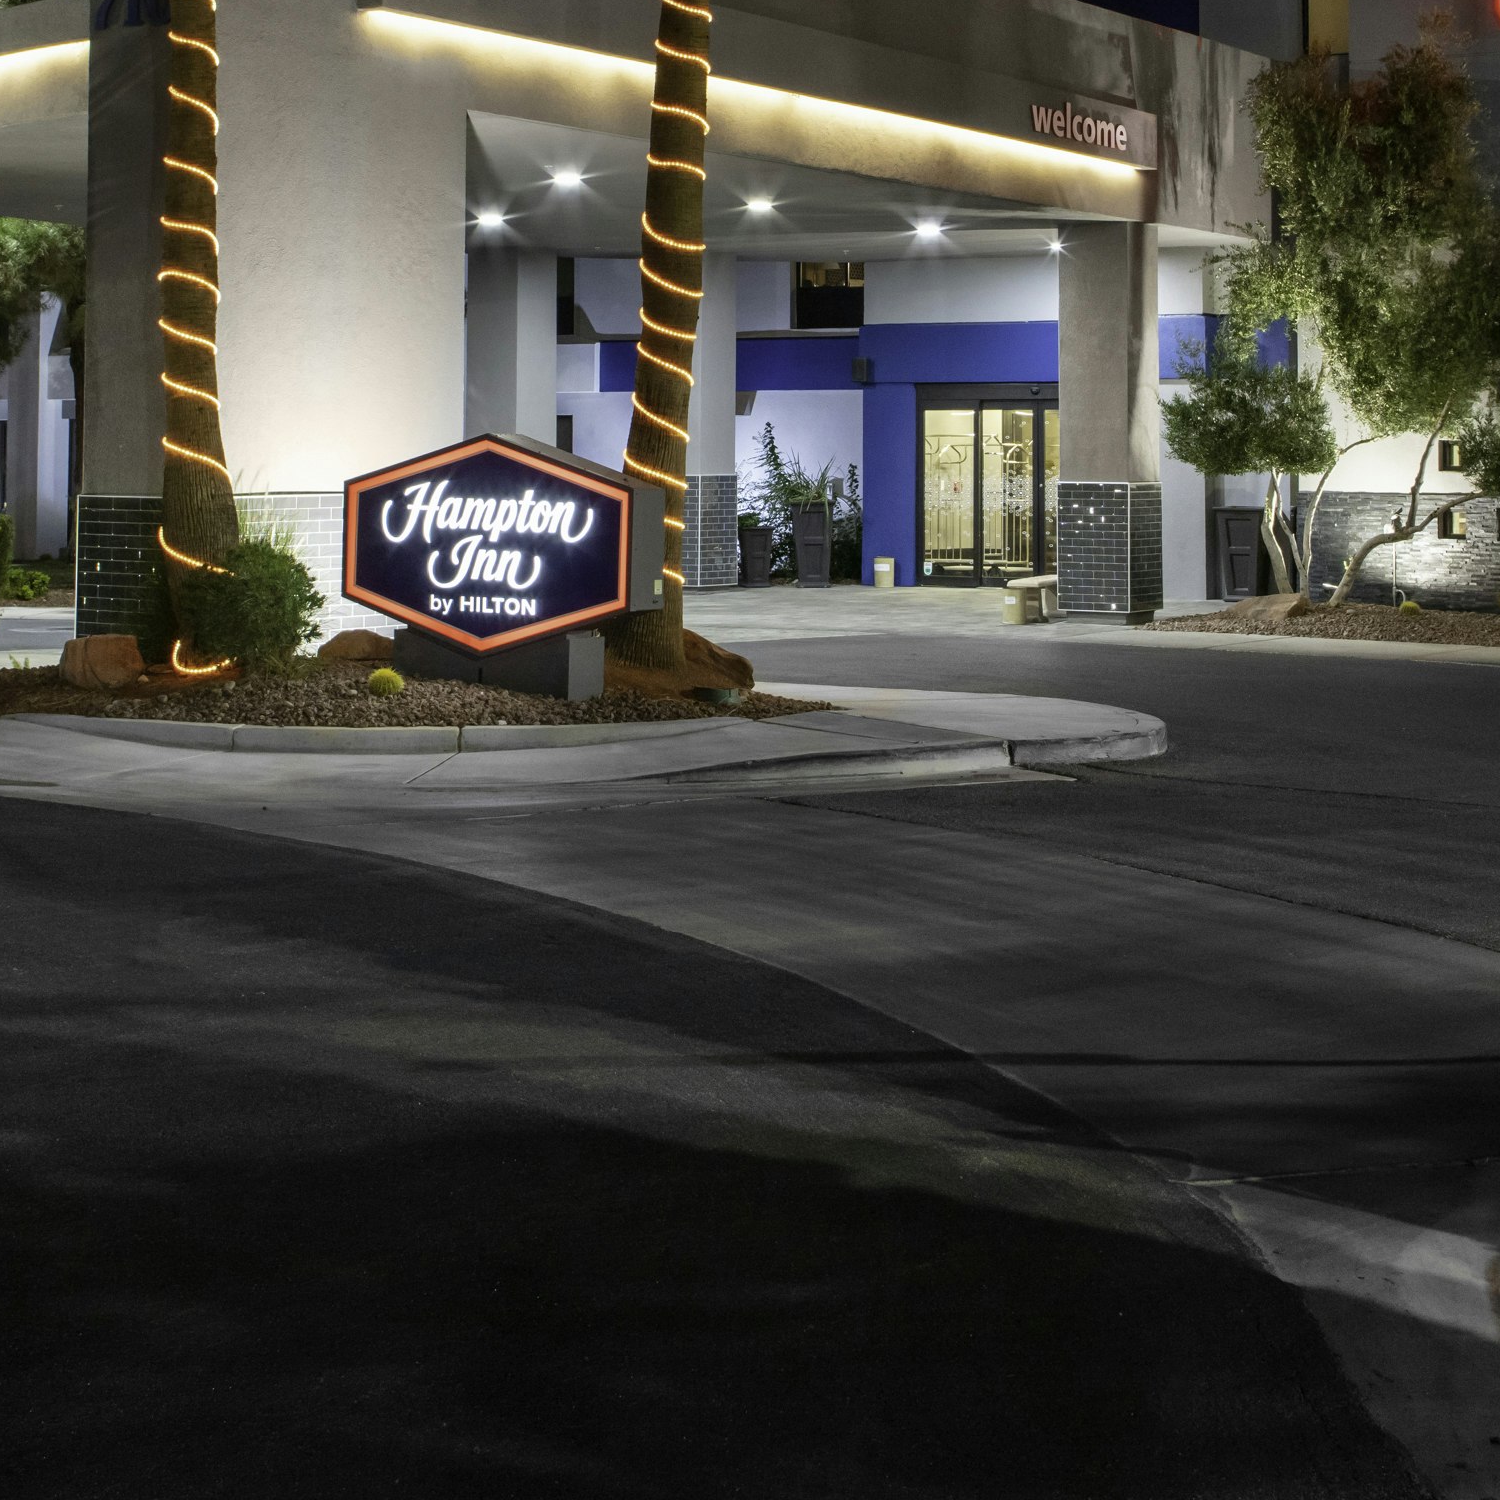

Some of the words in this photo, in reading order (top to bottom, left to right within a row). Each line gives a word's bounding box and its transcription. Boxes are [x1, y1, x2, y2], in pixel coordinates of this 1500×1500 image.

[1031, 102, 1128, 151] welcome
[382, 480, 594, 543] Hampton
[427, 535, 542, 590] Inn
[430, 594, 453, 615] by
[459, 595, 536, 616] HILTON
